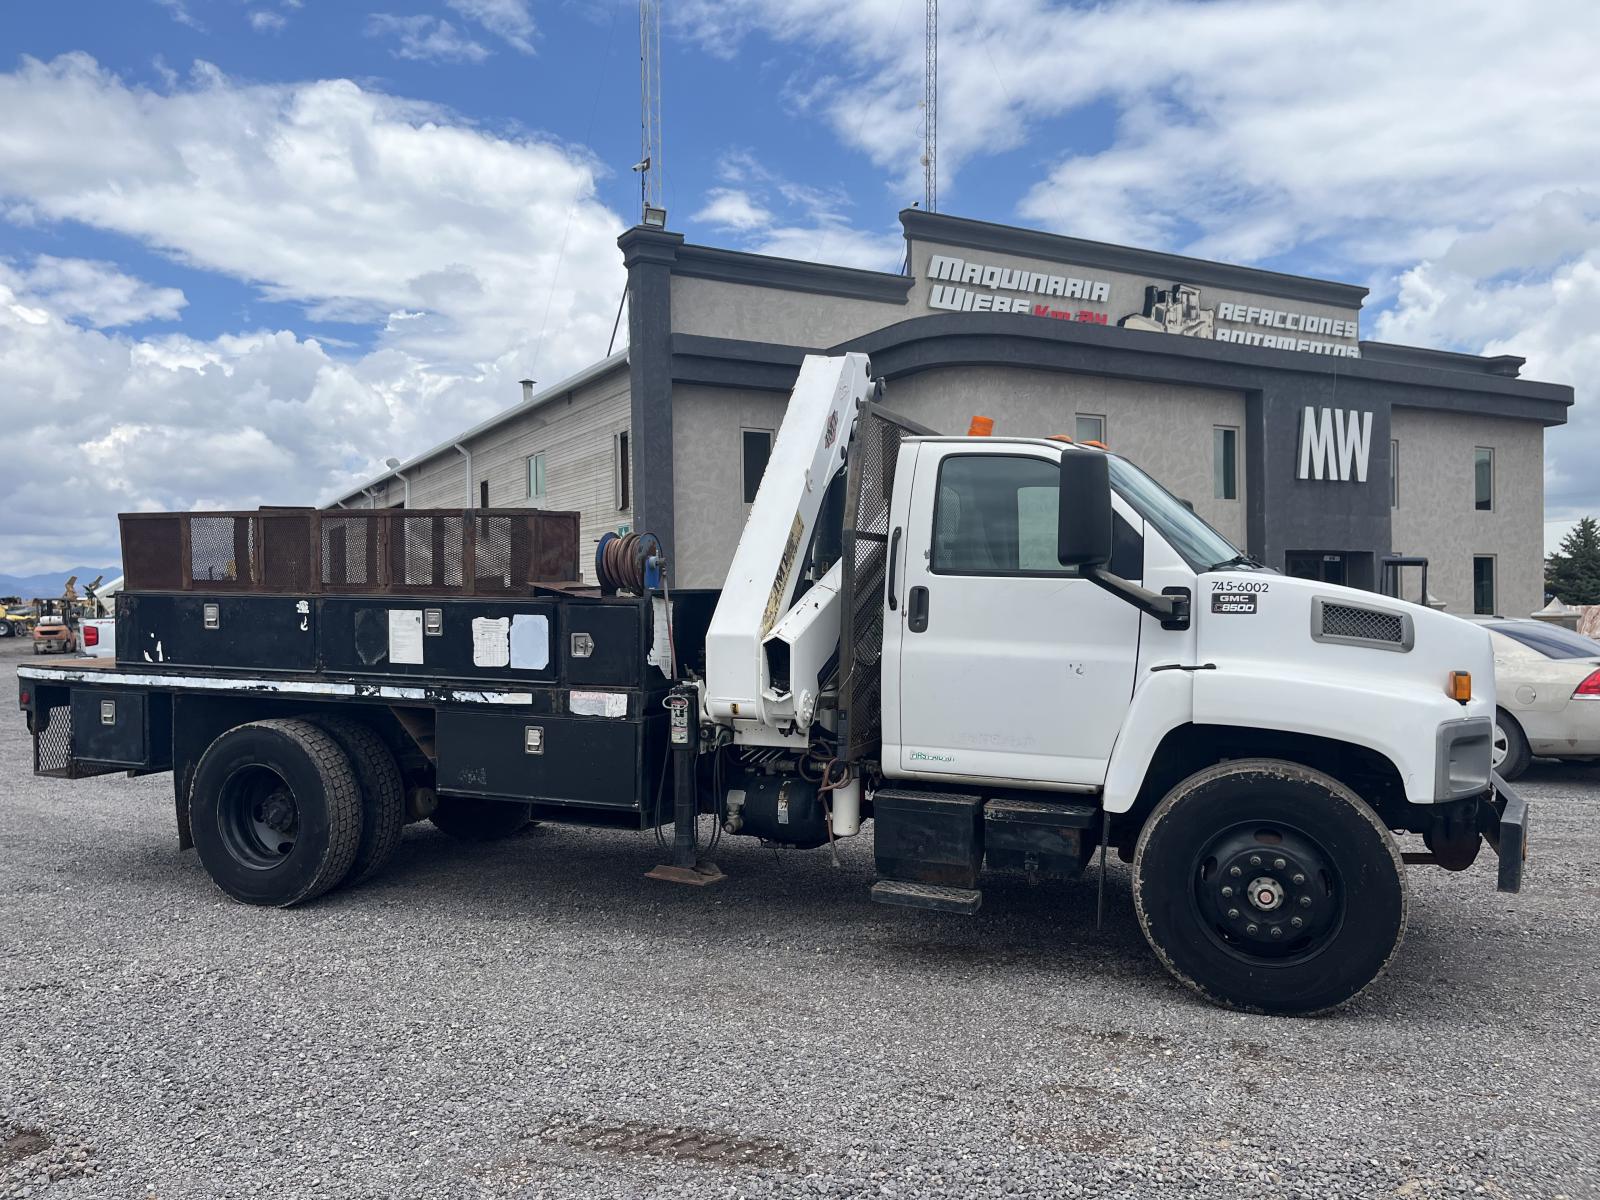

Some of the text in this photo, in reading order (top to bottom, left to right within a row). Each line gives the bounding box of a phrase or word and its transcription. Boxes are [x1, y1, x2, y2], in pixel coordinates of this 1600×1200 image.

[928, 255, 1110, 302] MAQUINARIA
[1218, 302, 1358, 338] REFACCIONES
[1297, 406, 1373, 482] MW
[1211, 581, 1269, 593] 745-6002
[1213, 603, 1255, 612] C8500
